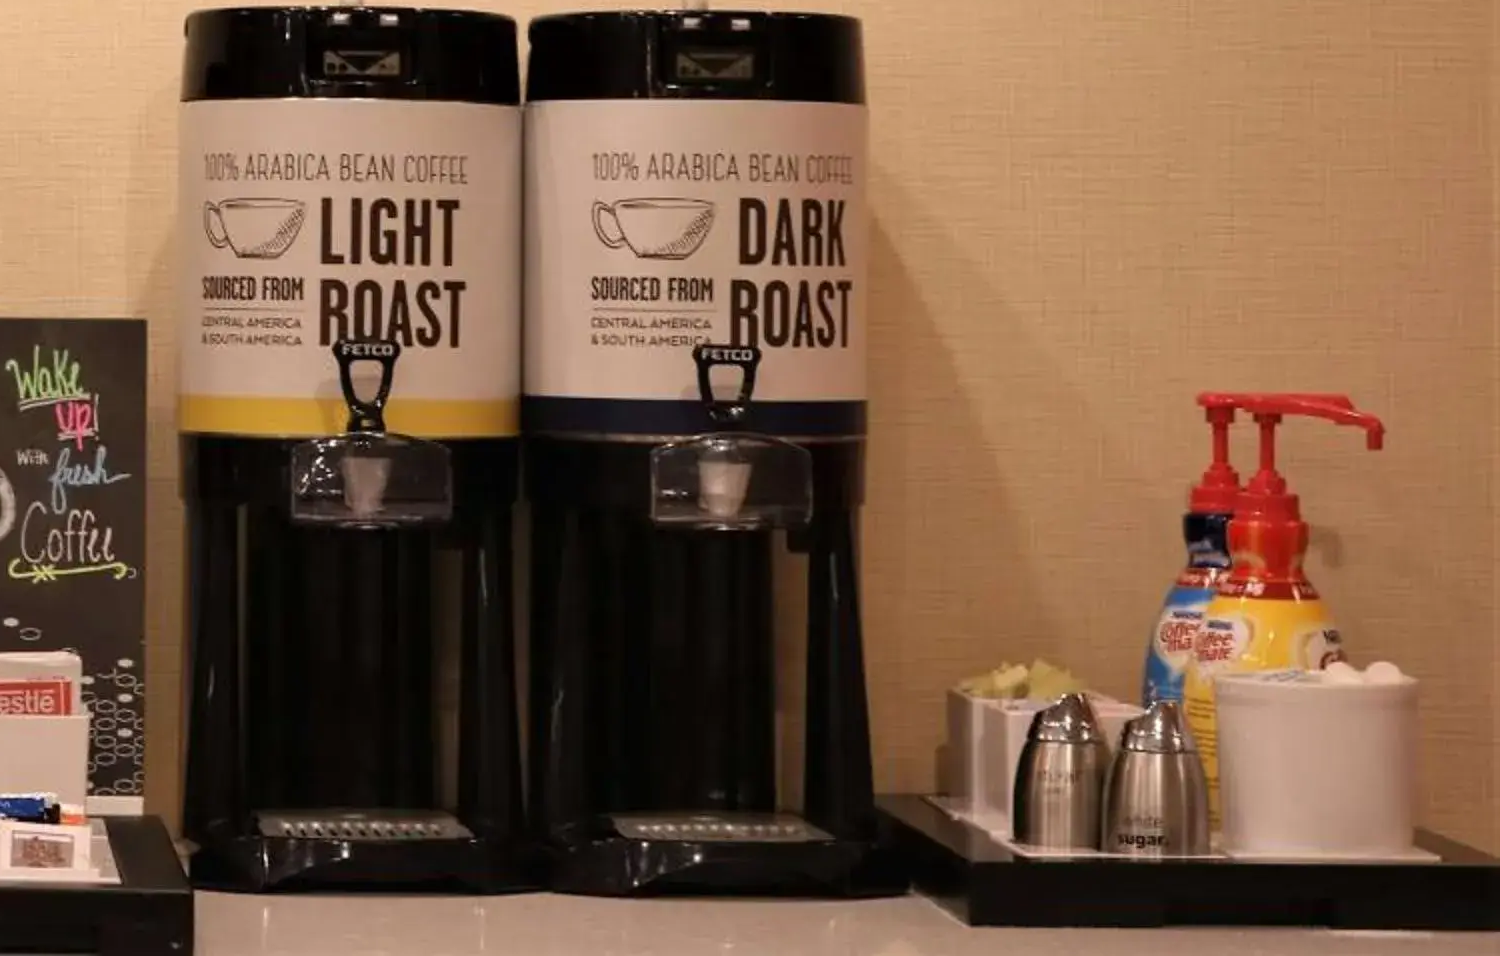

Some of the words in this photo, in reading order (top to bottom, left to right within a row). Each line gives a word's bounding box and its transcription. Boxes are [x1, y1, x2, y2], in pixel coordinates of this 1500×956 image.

[203, 152, 240, 182] 100%
[244, 153, 331, 182] ARABICA
[339, 153, 395, 183] BEAN
[403, 155, 468, 185] COFFEE
[591, 152, 640, 182] 100%
[646, 153, 741, 182] ARABICA
[748, 154, 800, 184] BEAN
[805, 155, 854, 185] COFFEE
[320, 197, 460, 266] LIGHT
[739, 197, 846, 266] DARK
[201, 276, 257, 301] SOURCED
[262, 276, 305, 301] FROM
[590, 276, 661, 302] SOURCED
[667, 277, 714, 302] FROM
[246, 317, 303, 330] AMERICA
[320, 279, 467, 348] ROAST
[590, 317, 648, 329] CENTRAL
[650, 317, 713, 330] AMERICA
[730, 279, 853, 348] ROAST
[246, 333, 303, 346] AMERICA
[341, 344, 395, 357] FETCO
[601, 334, 646, 346] SOUTH
[648, 335, 713, 347] AMERICA
[701, 348, 755, 361] FETCO
[49, 445, 133, 516] fresh
[20, 500, 116, 564] Coffee
